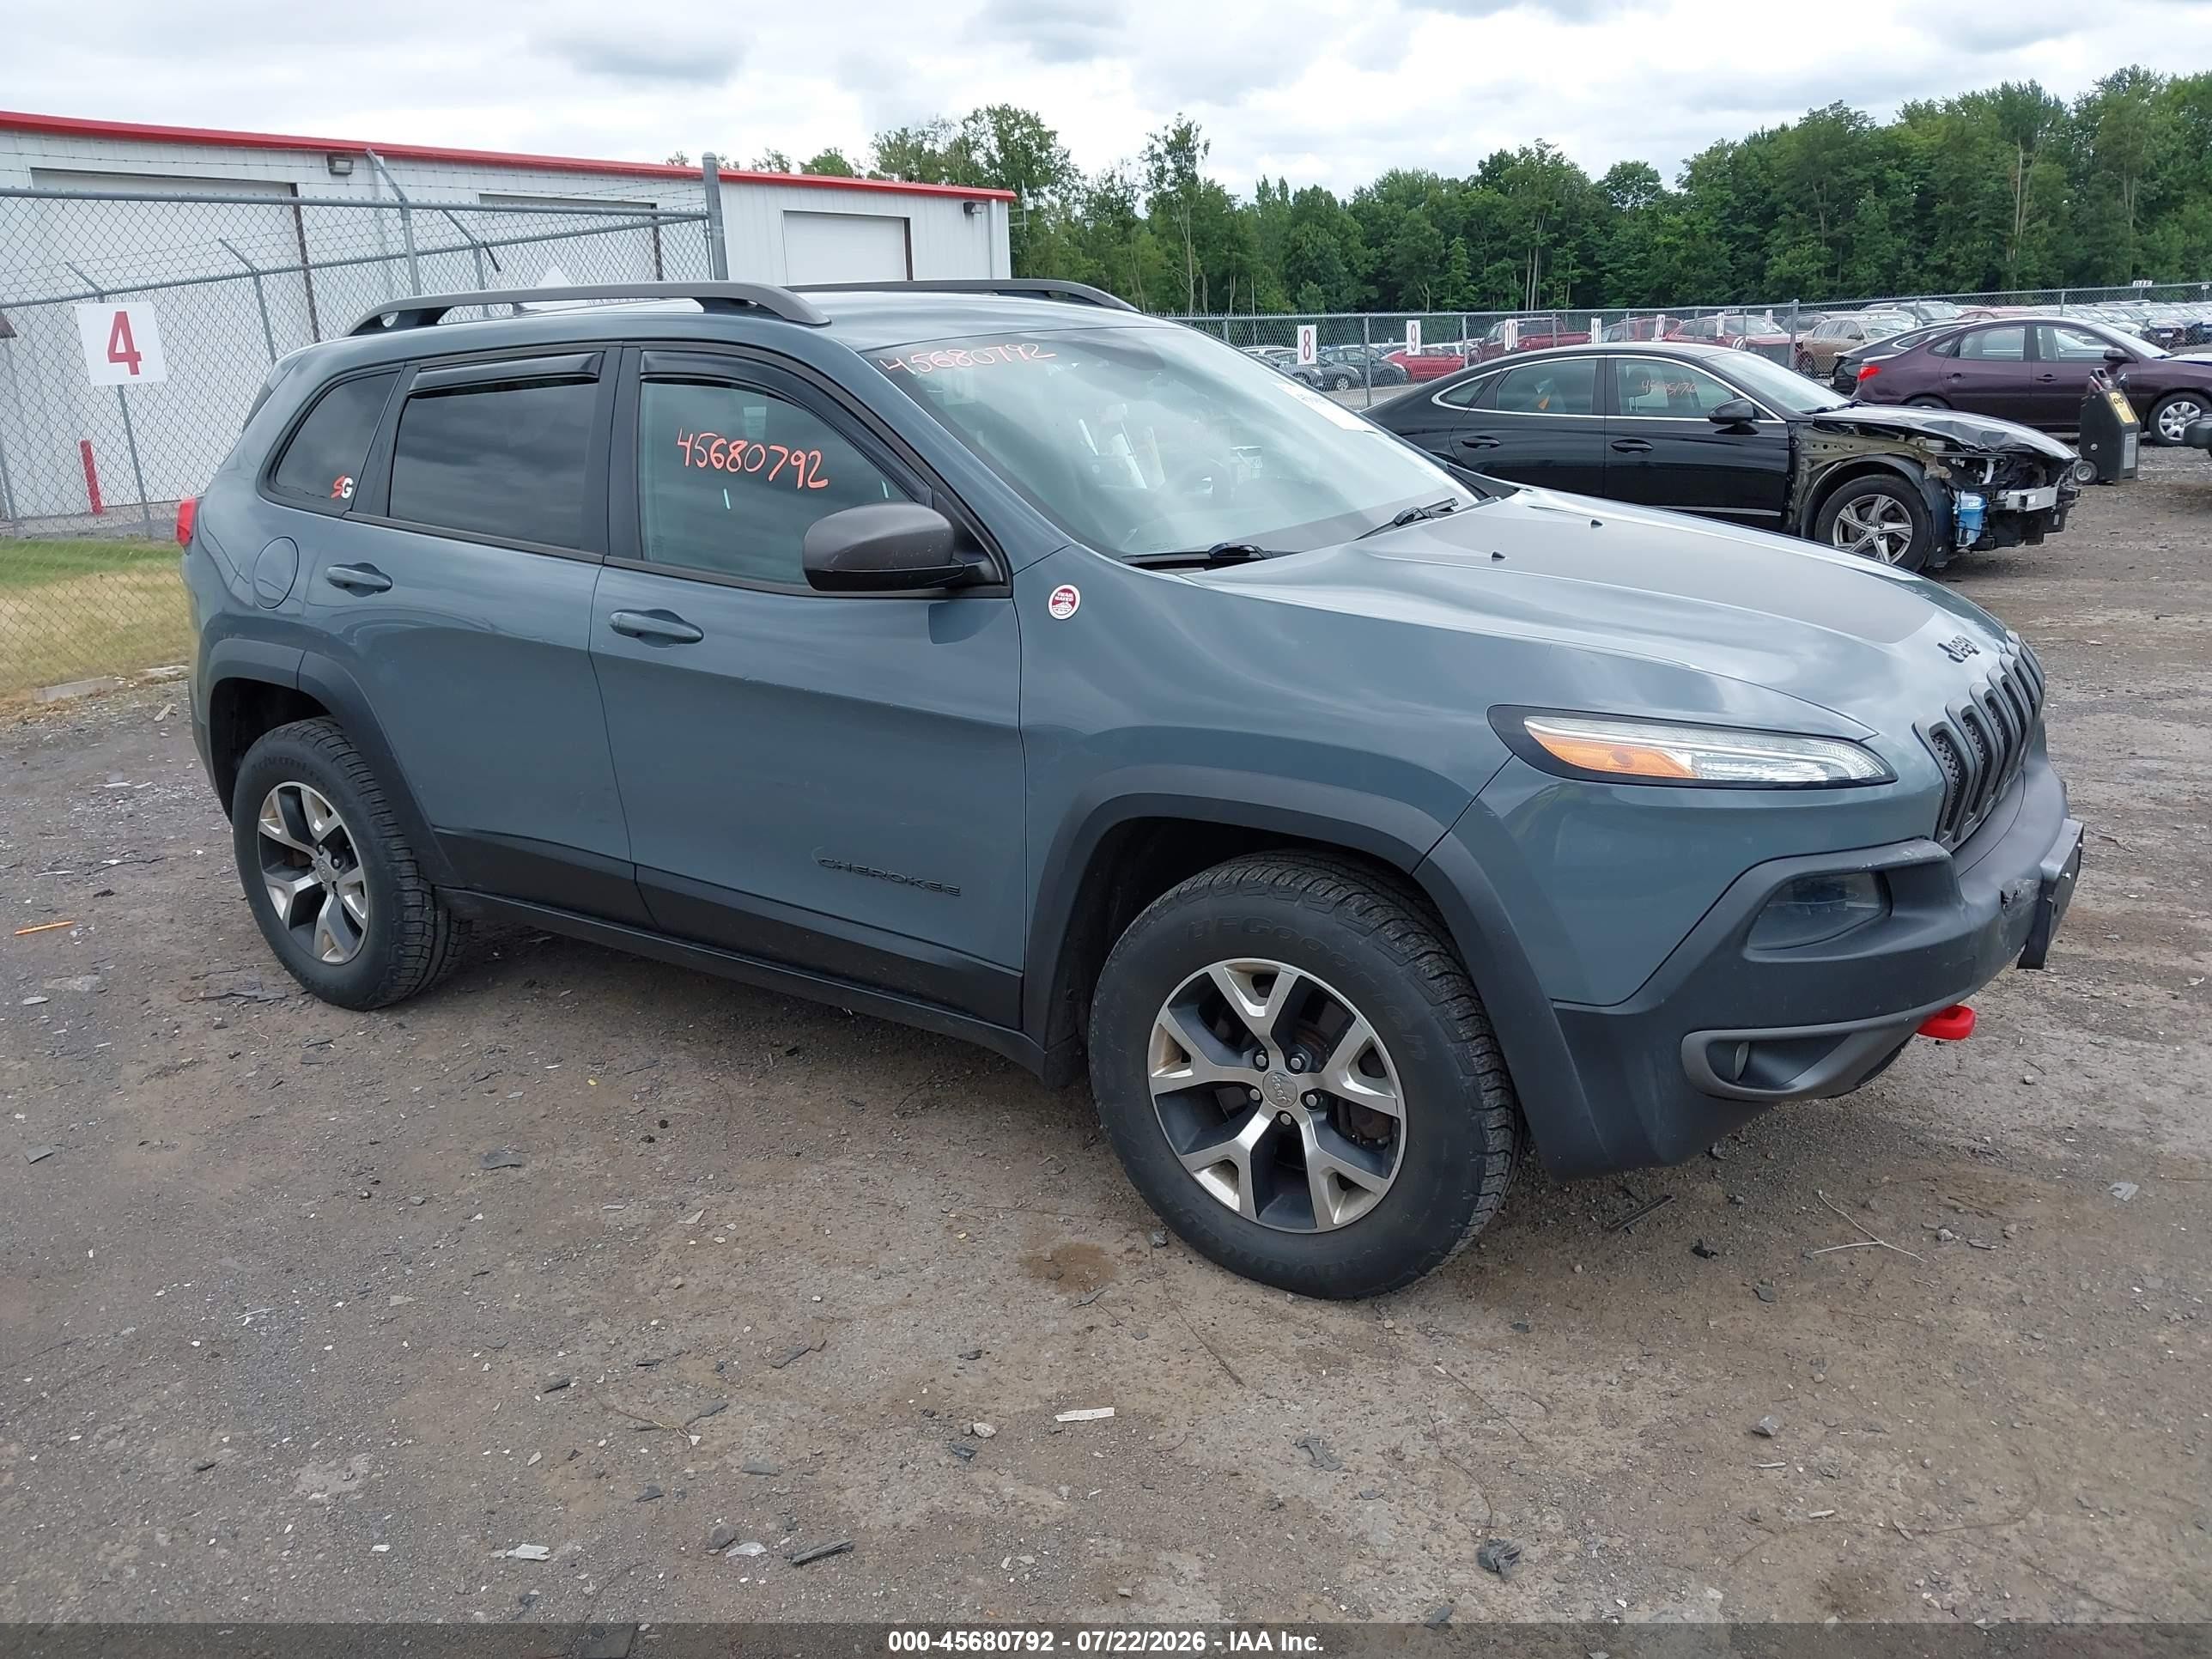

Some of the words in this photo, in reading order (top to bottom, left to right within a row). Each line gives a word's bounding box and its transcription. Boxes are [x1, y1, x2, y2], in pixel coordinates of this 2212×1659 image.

[107, 310, 143, 376] 4
[1303, 329, 1312, 362] 8
[1410, 323, 1418, 353] 9
[1506, 321, 1516, 348] 10
[1592, 320, 1601, 343] 11
[878, 343, 1057, 376] 45680792
[677, 427, 830, 490] 45680792
[1937, 635, 1981, 664] Jeep
[817, 857, 961, 896] CHEROKEE
